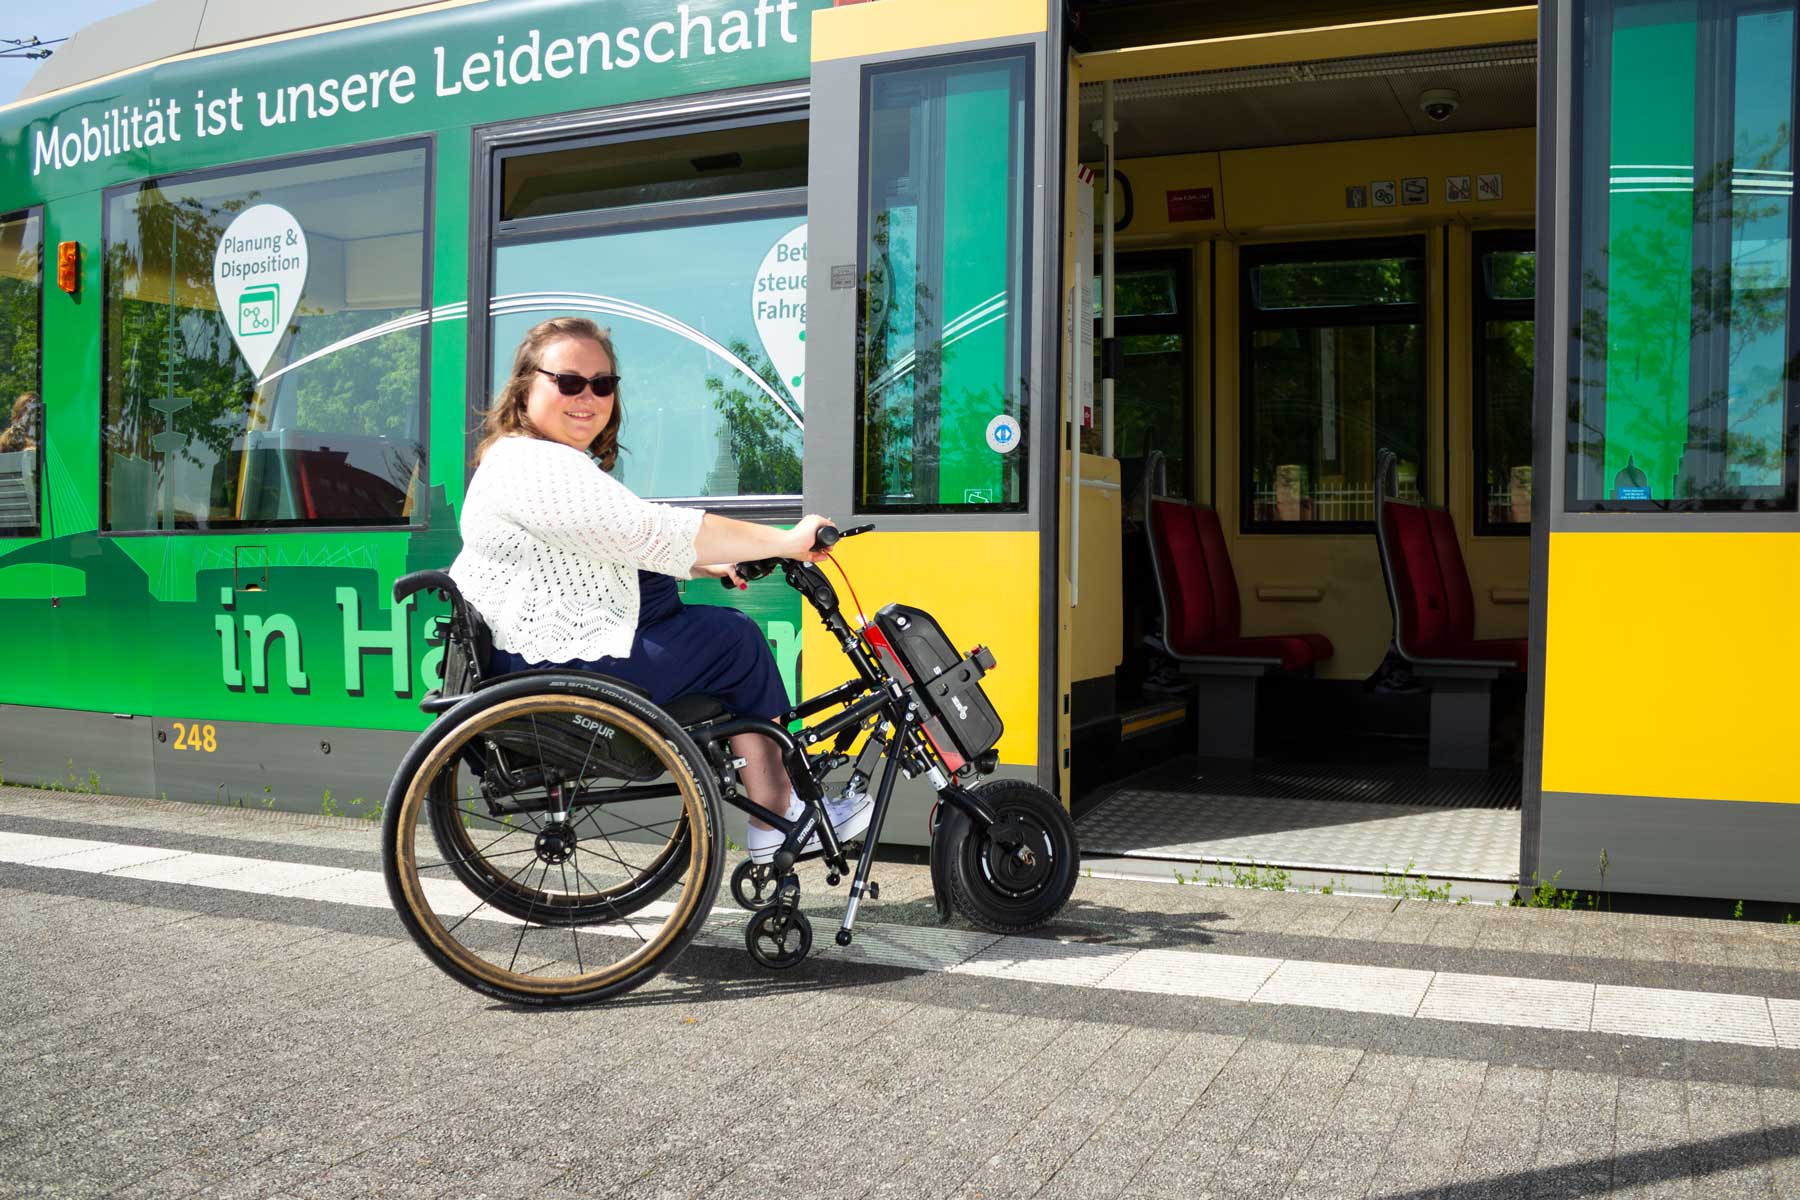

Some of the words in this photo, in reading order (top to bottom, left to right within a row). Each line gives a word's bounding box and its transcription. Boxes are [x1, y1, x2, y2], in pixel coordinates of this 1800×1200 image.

[33, 98, 181, 176] Mobilität
[195, 88, 244, 138] ist
[257, 64, 417, 128] unsere
[434, 0, 798, 97] Leidenschaft
[224, 234, 282, 255] Planung
[285, 228, 298, 246] &
[221, 255, 300, 280] Disposition
[214, 586, 310, 696] in
[172, 722, 217, 753] 248
[572, 714, 616, 739] SOPUR
